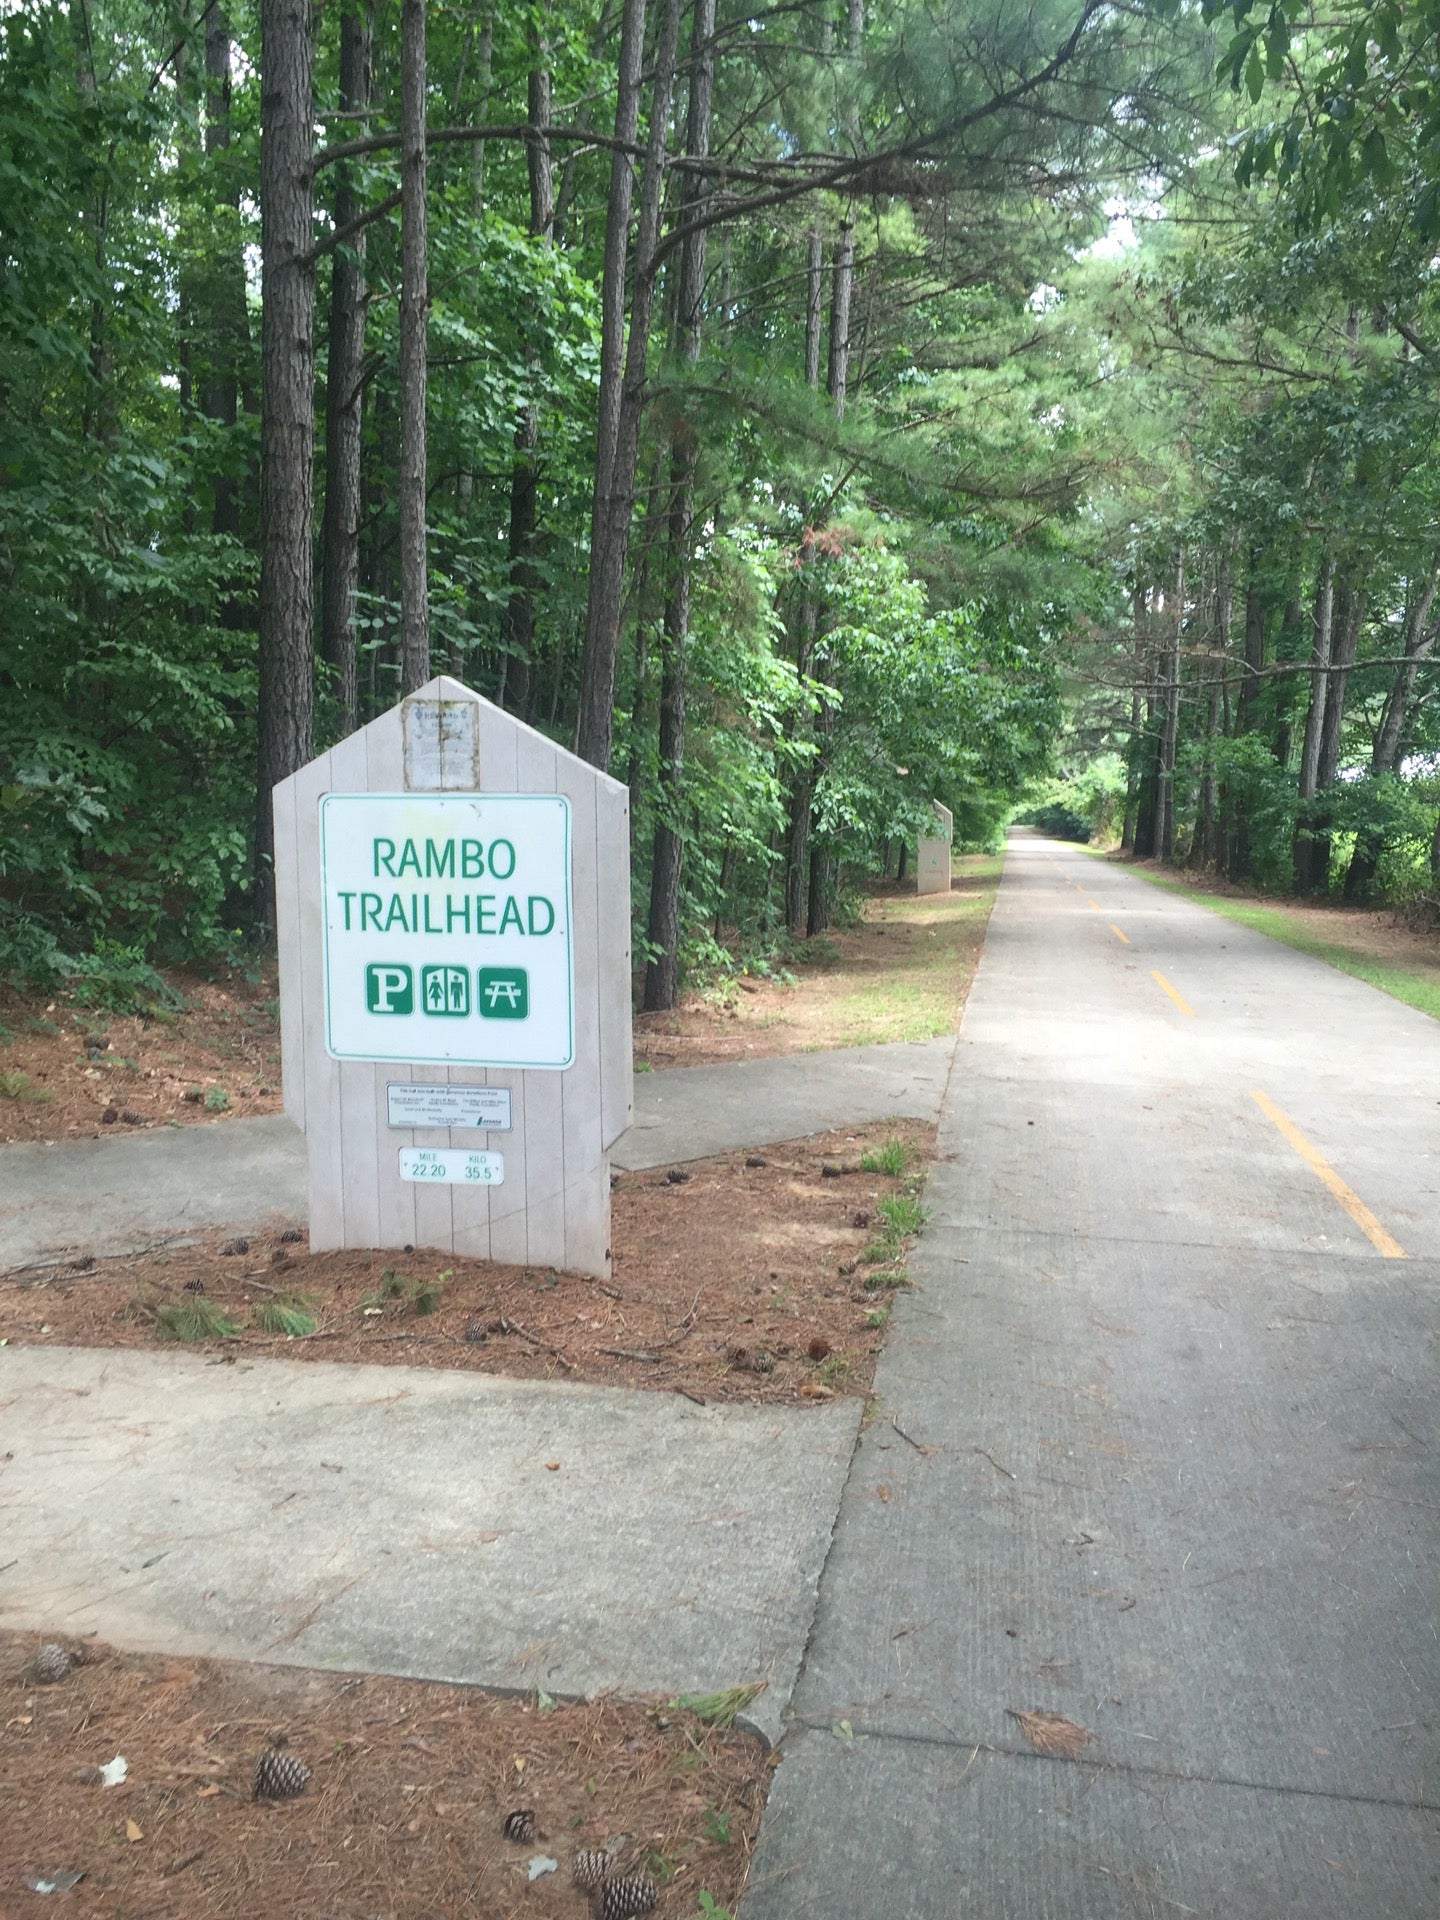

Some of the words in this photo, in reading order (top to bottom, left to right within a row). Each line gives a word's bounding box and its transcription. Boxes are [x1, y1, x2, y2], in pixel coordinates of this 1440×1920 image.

[373, 838, 516, 880] RAMBO
[338, 892, 555, 935] TRAILHEAD
[372, 969, 408, 1012] P
[419, 1152, 438, 1162] MILE
[468, 1154, 487, 1165] KILO
[411, 1163, 446, 1177] 22.20
[464, 1165, 492, 1180] 35.5
